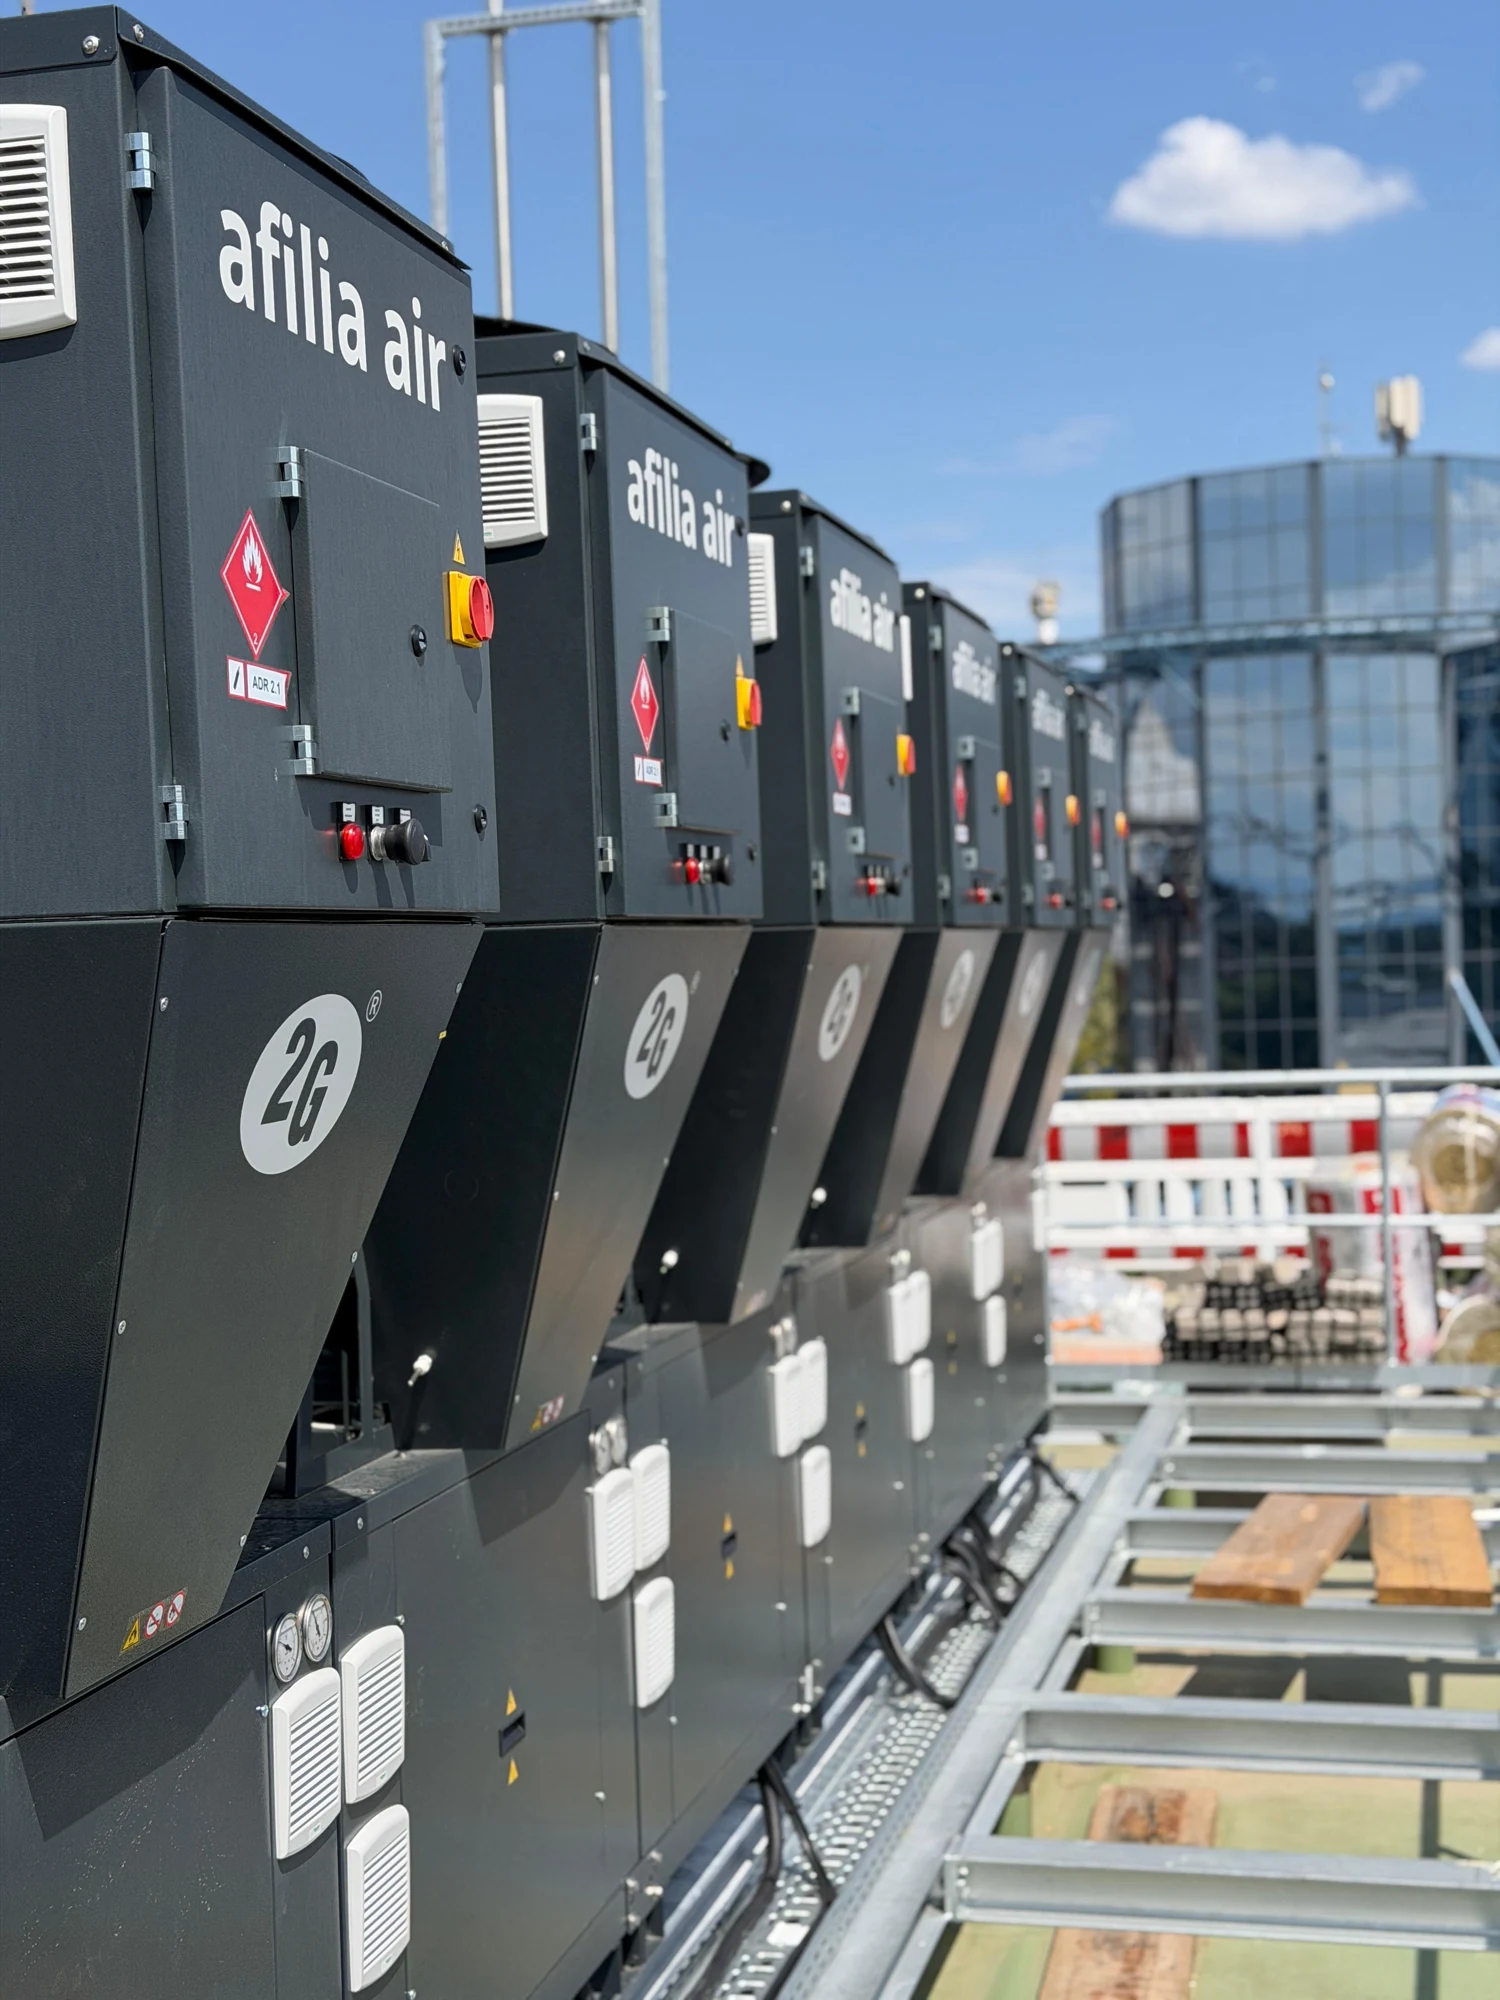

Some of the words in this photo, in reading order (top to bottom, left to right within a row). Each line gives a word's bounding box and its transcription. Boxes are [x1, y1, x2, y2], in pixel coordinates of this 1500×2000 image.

[219, 201, 367, 373] afilia
[384, 296, 446, 412] air
[627, 447, 697, 550] afilia
[702, 488, 735, 568] air
[252, 675, 269, 693] ADR
[270, 680, 281, 696] 2.1
[253, 632, 259, 645] 2
[260, 1017, 339, 1147] 2G
[635, 989, 676, 1080] 2G
